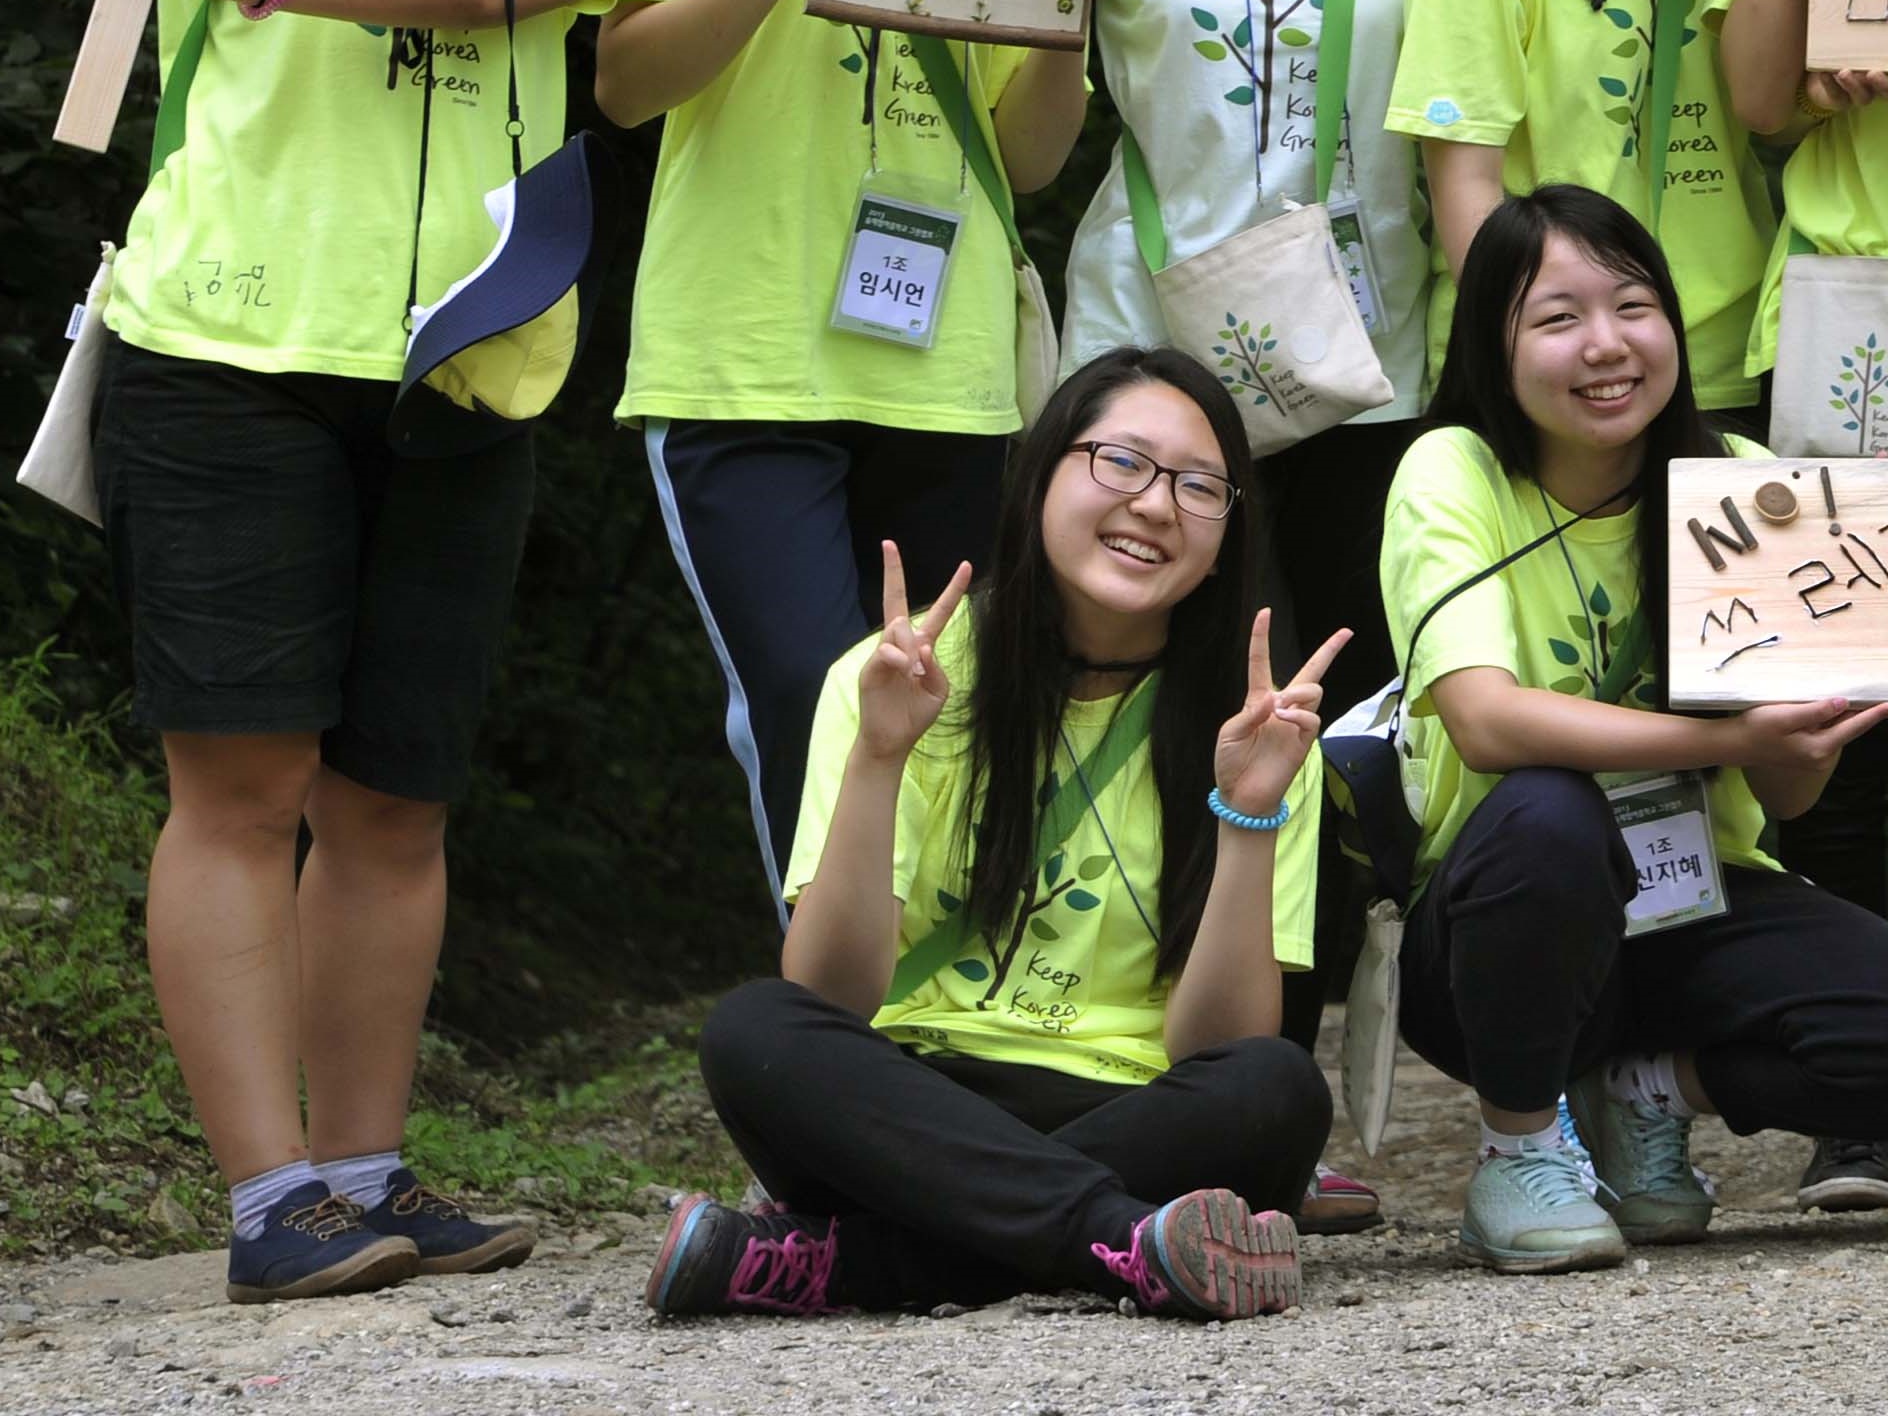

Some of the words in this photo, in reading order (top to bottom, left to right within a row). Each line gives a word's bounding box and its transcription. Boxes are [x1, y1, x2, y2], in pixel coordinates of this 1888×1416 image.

[1671, 101, 1708, 129] eep
[1666, 134, 1719, 154] orea
[881, 255, 910, 273] 1조
[858, 270, 926, 308] 임시언
[1686, 465, 1843, 573] NO!
[1645, 836, 1674, 856] 1조
[1635, 853, 1703, 893] 신지혜
[1026, 950, 1082, 996] Keep
[1009, 985, 1079, 1019] Korea
